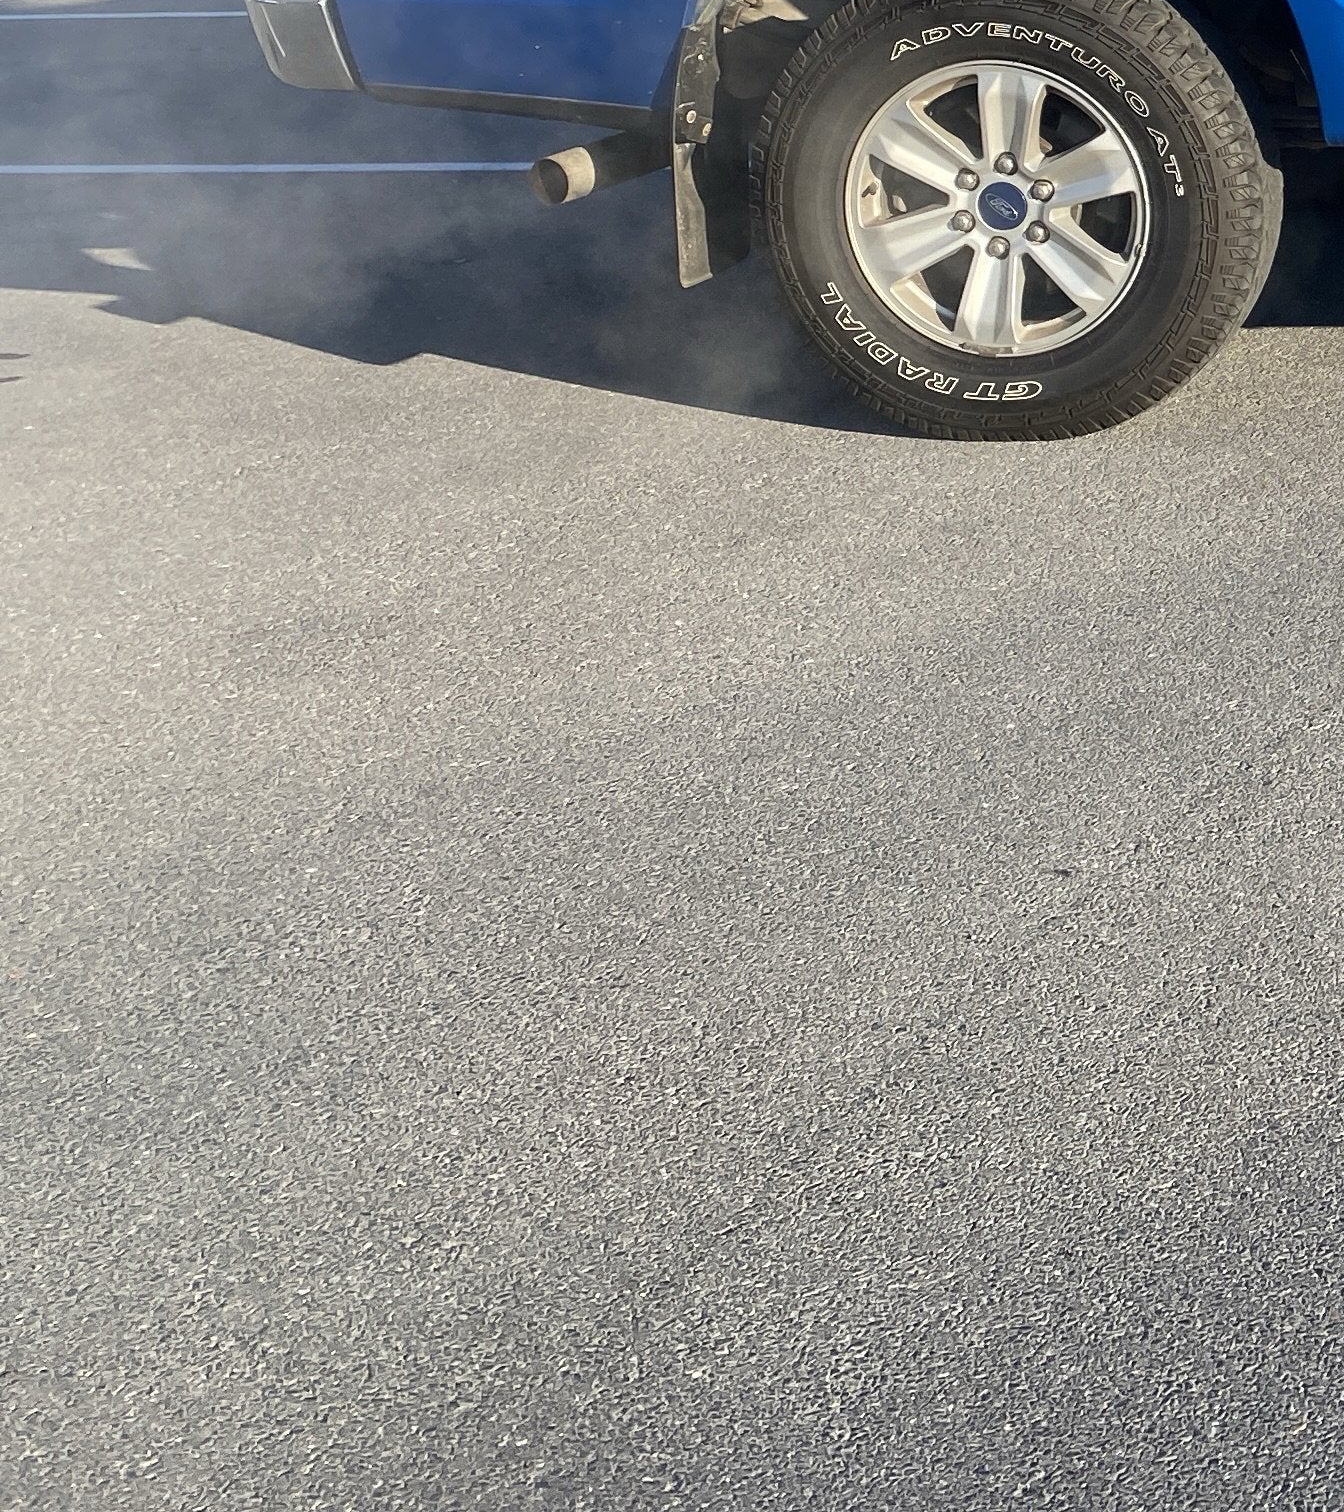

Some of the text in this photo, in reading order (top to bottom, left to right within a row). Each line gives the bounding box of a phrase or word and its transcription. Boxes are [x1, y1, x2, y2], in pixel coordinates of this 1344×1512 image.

[890, 22, 1150, 118] ADVENTURO
[820, 282, 1043, 401] GT RADIAL
